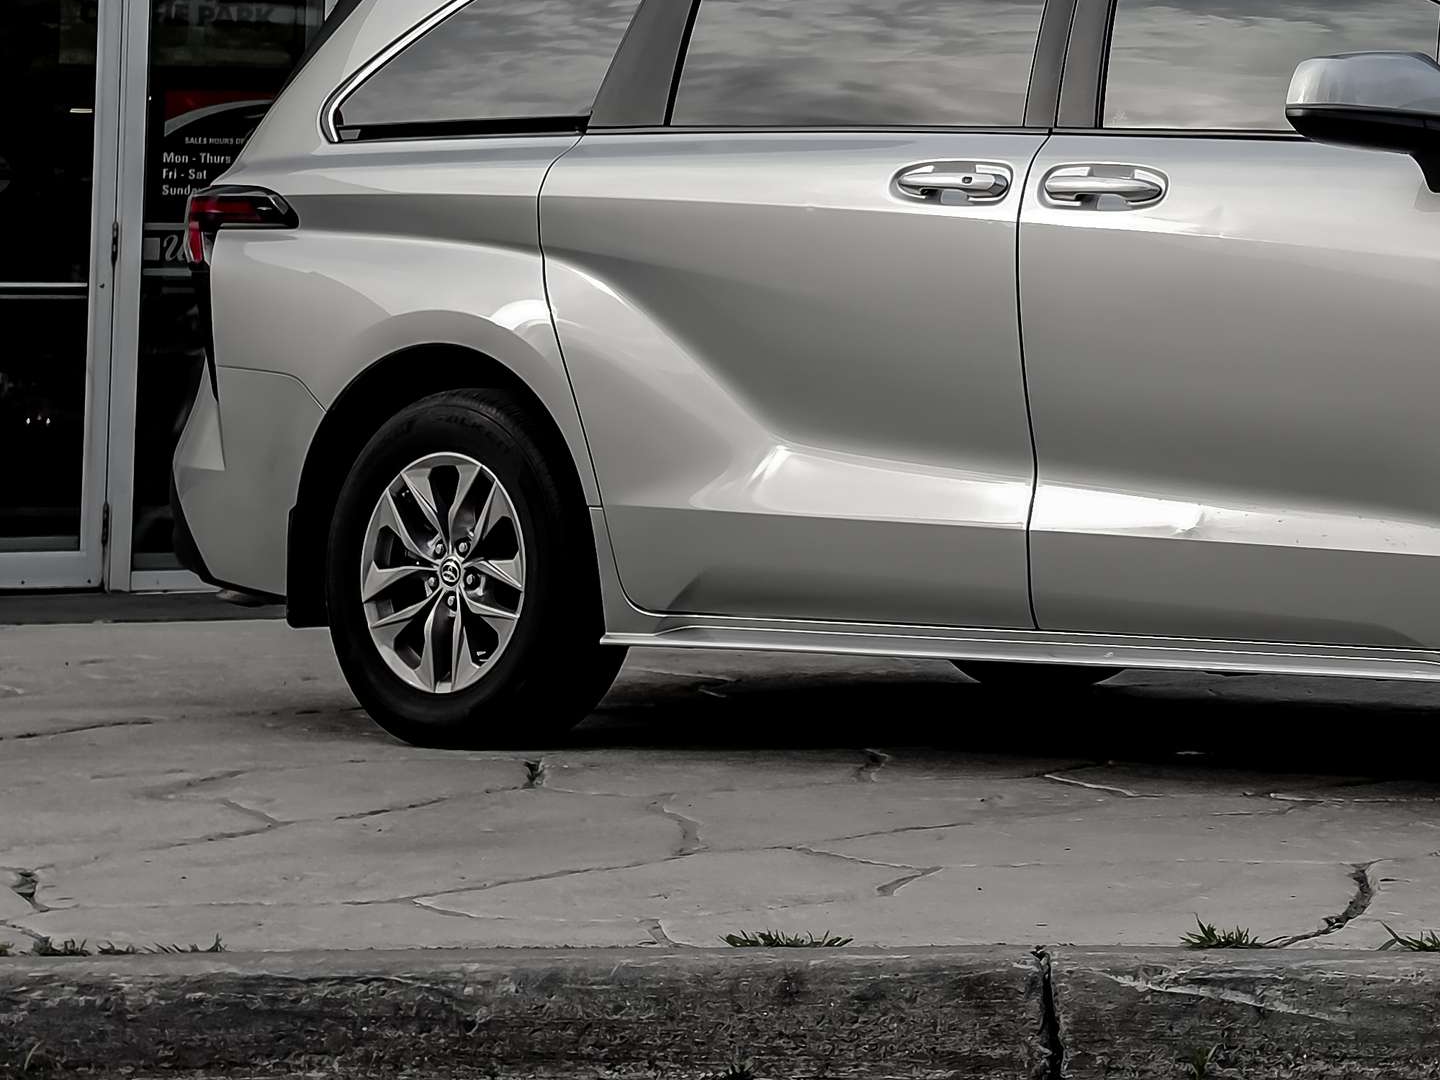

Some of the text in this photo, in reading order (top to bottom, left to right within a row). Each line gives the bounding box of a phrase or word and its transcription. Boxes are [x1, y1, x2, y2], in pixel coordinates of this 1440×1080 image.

[185, 137, 207, 145] SALES
[163, 152, 189, 164] Mon
[200, 152, 231, 164] Thurs
[162, 168, 177, 180] Fri
[188, 168, 207, 180] Sat
